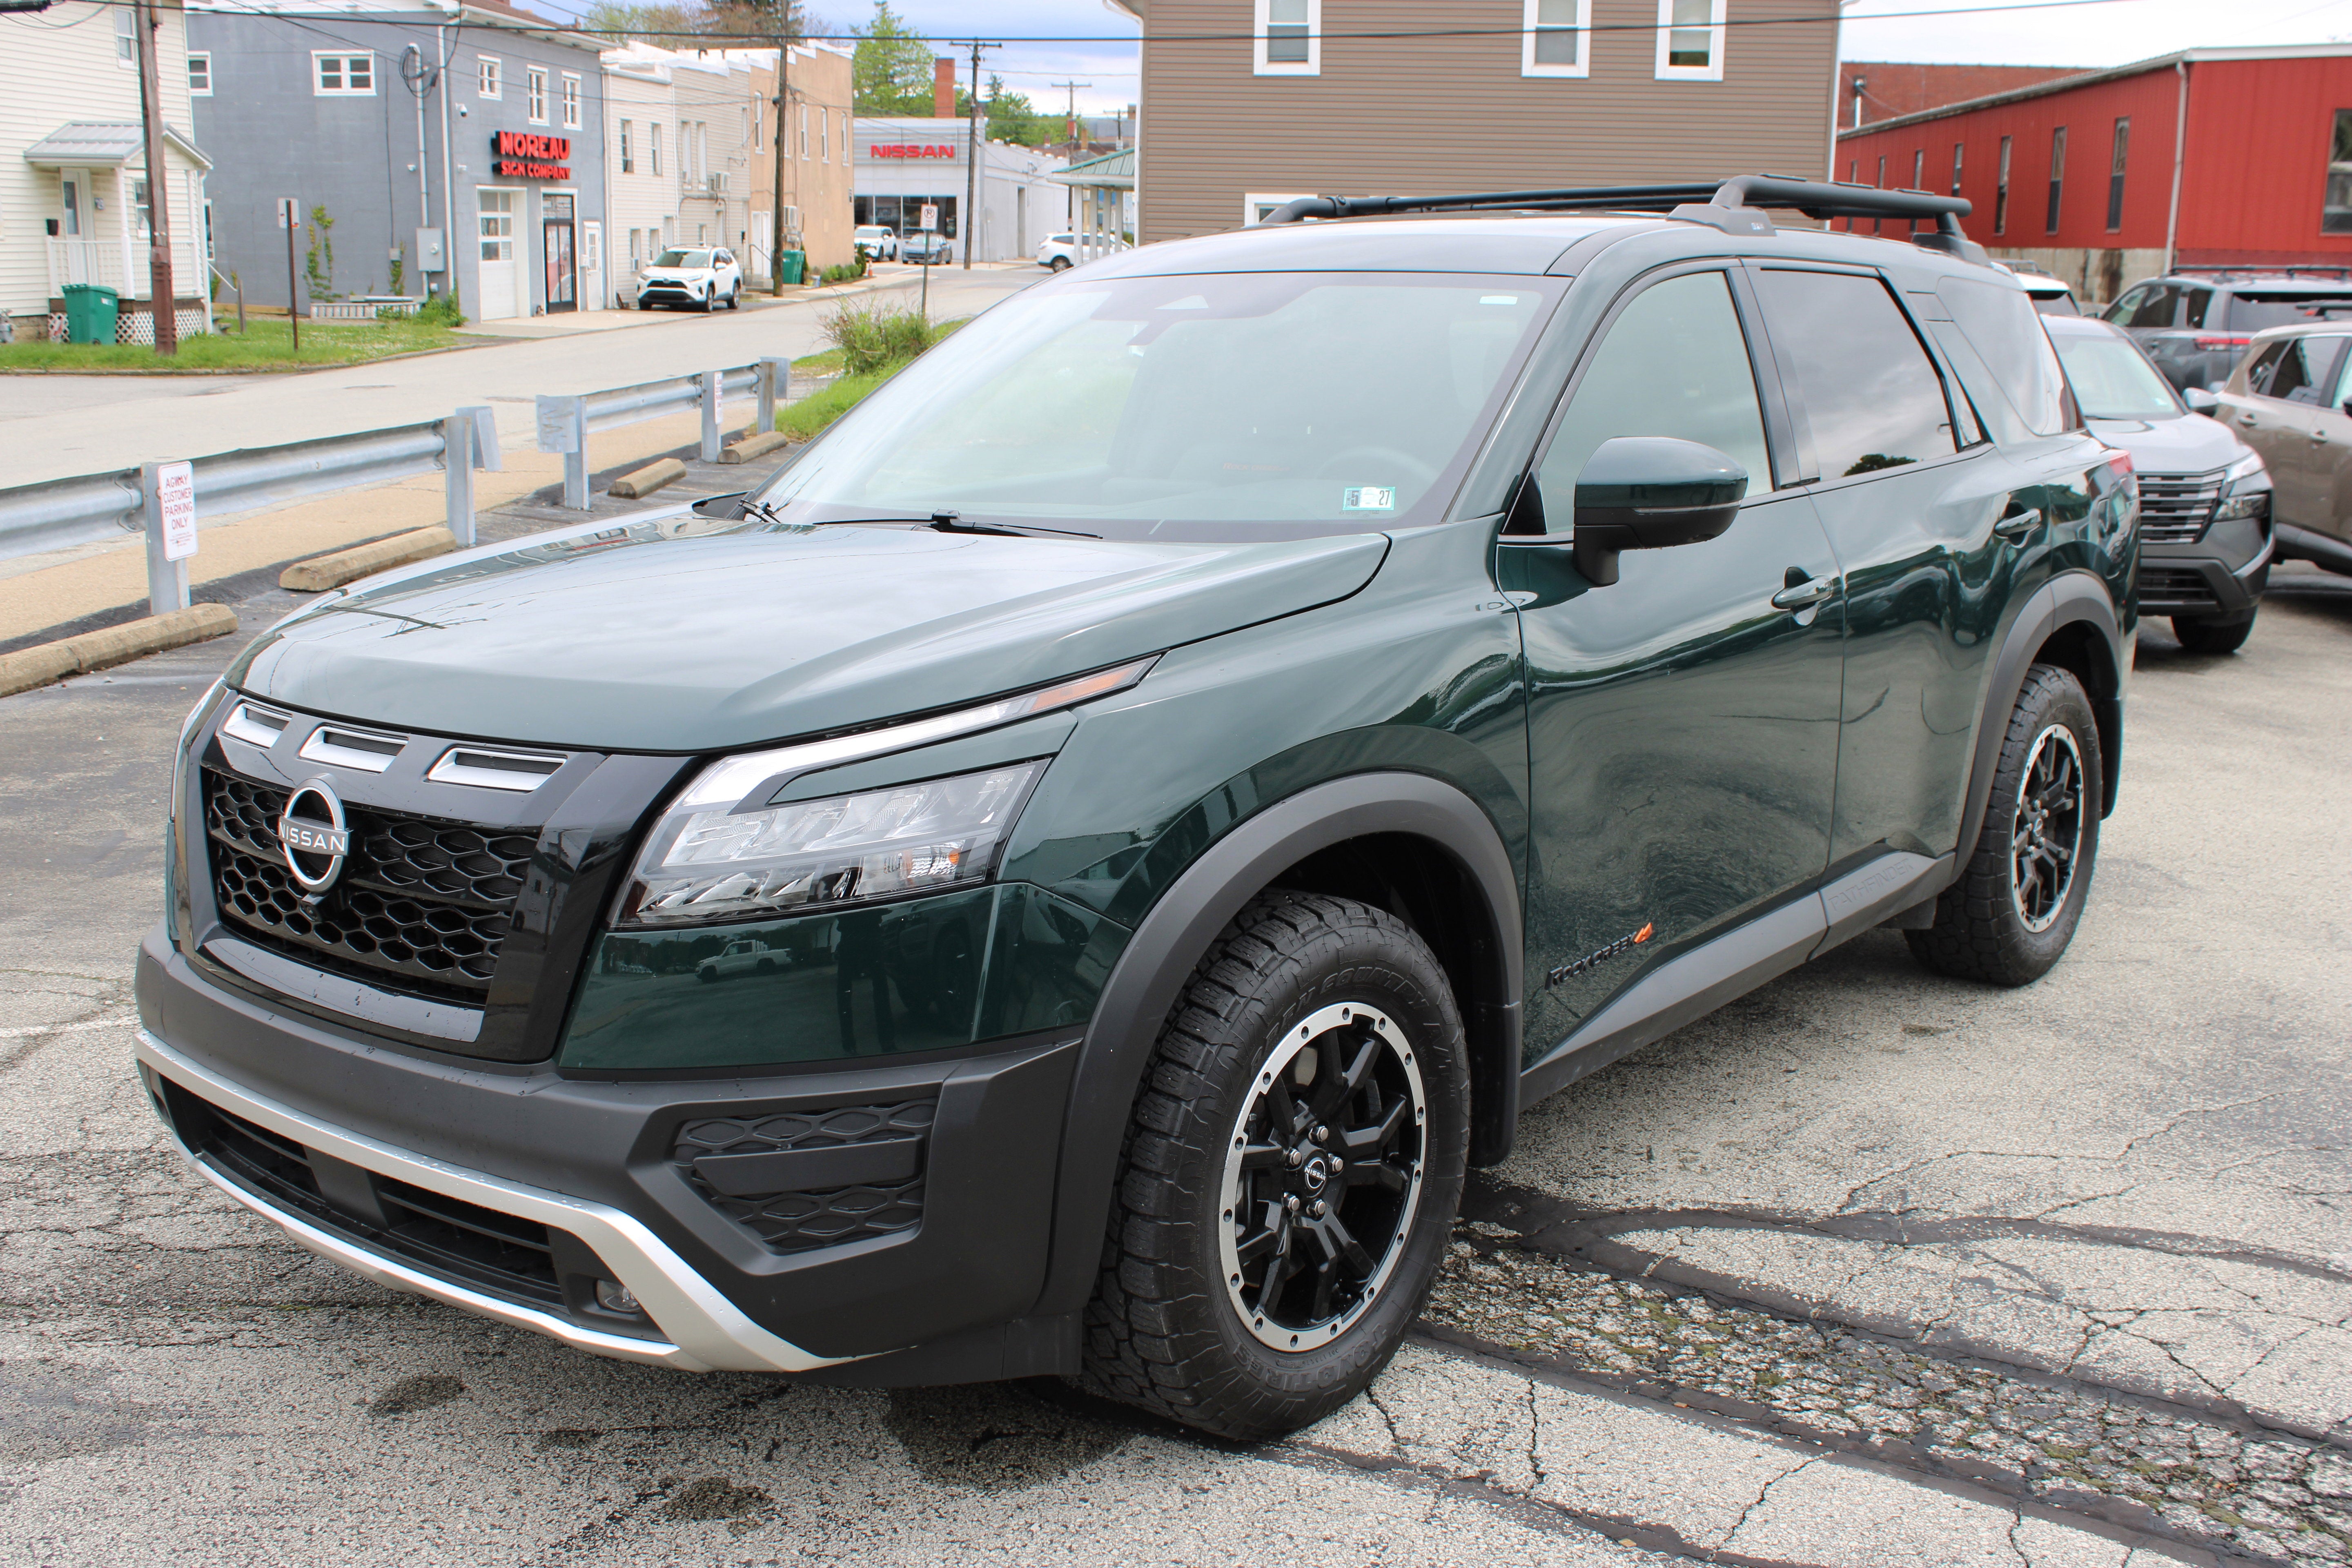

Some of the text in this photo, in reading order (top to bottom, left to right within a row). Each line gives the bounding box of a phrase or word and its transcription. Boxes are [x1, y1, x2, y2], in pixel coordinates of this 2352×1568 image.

[500, 130, 570, 160] MOREAU
[871, 145, 954, 158] NISSAN
[501, 161, 570, 179] SIGN COMPANY
[166, 474, 189, 488] AGWAY
[164, 488, 192, 503] CUSTOMER
[1351, 490, 1390, 506] 5 27
[165, 501, 193, 517] PARKING
[172, 516, 188, 530] ONLY
[279, 822, 345, 851] NISSAN
[1544, 931, 1637, 990] ROCK CREEK
[1319, 967, 1429, 1009] COUNTRY
[1305, 1167, 1326, 1180] NISSAN
[1234, 1323, 1387, 1392] TOYO TIRES
